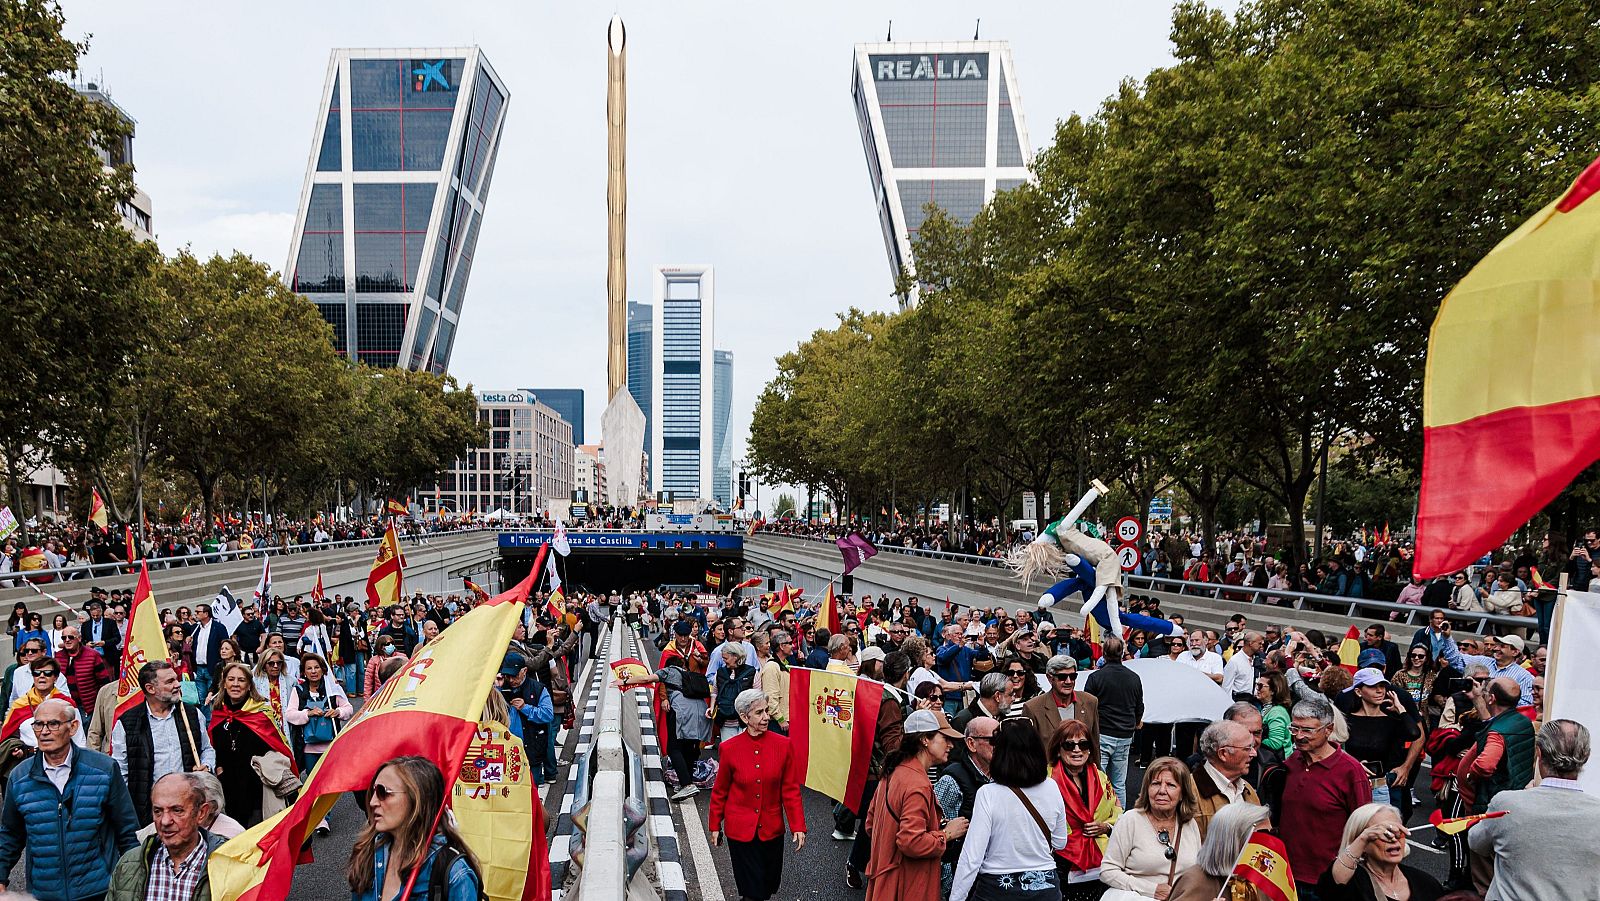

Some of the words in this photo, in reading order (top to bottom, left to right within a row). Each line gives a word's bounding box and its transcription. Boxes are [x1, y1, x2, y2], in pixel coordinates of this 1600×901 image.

[877, 55, 982, 80] REALIA
[482, 393, 507, 403] testa
[1121, 526, 1136, 536] 50
[519, 536, 543, 544] Túnel
[585, 536, 596, 544] de
[599, 536, 633, 544] Castilla
